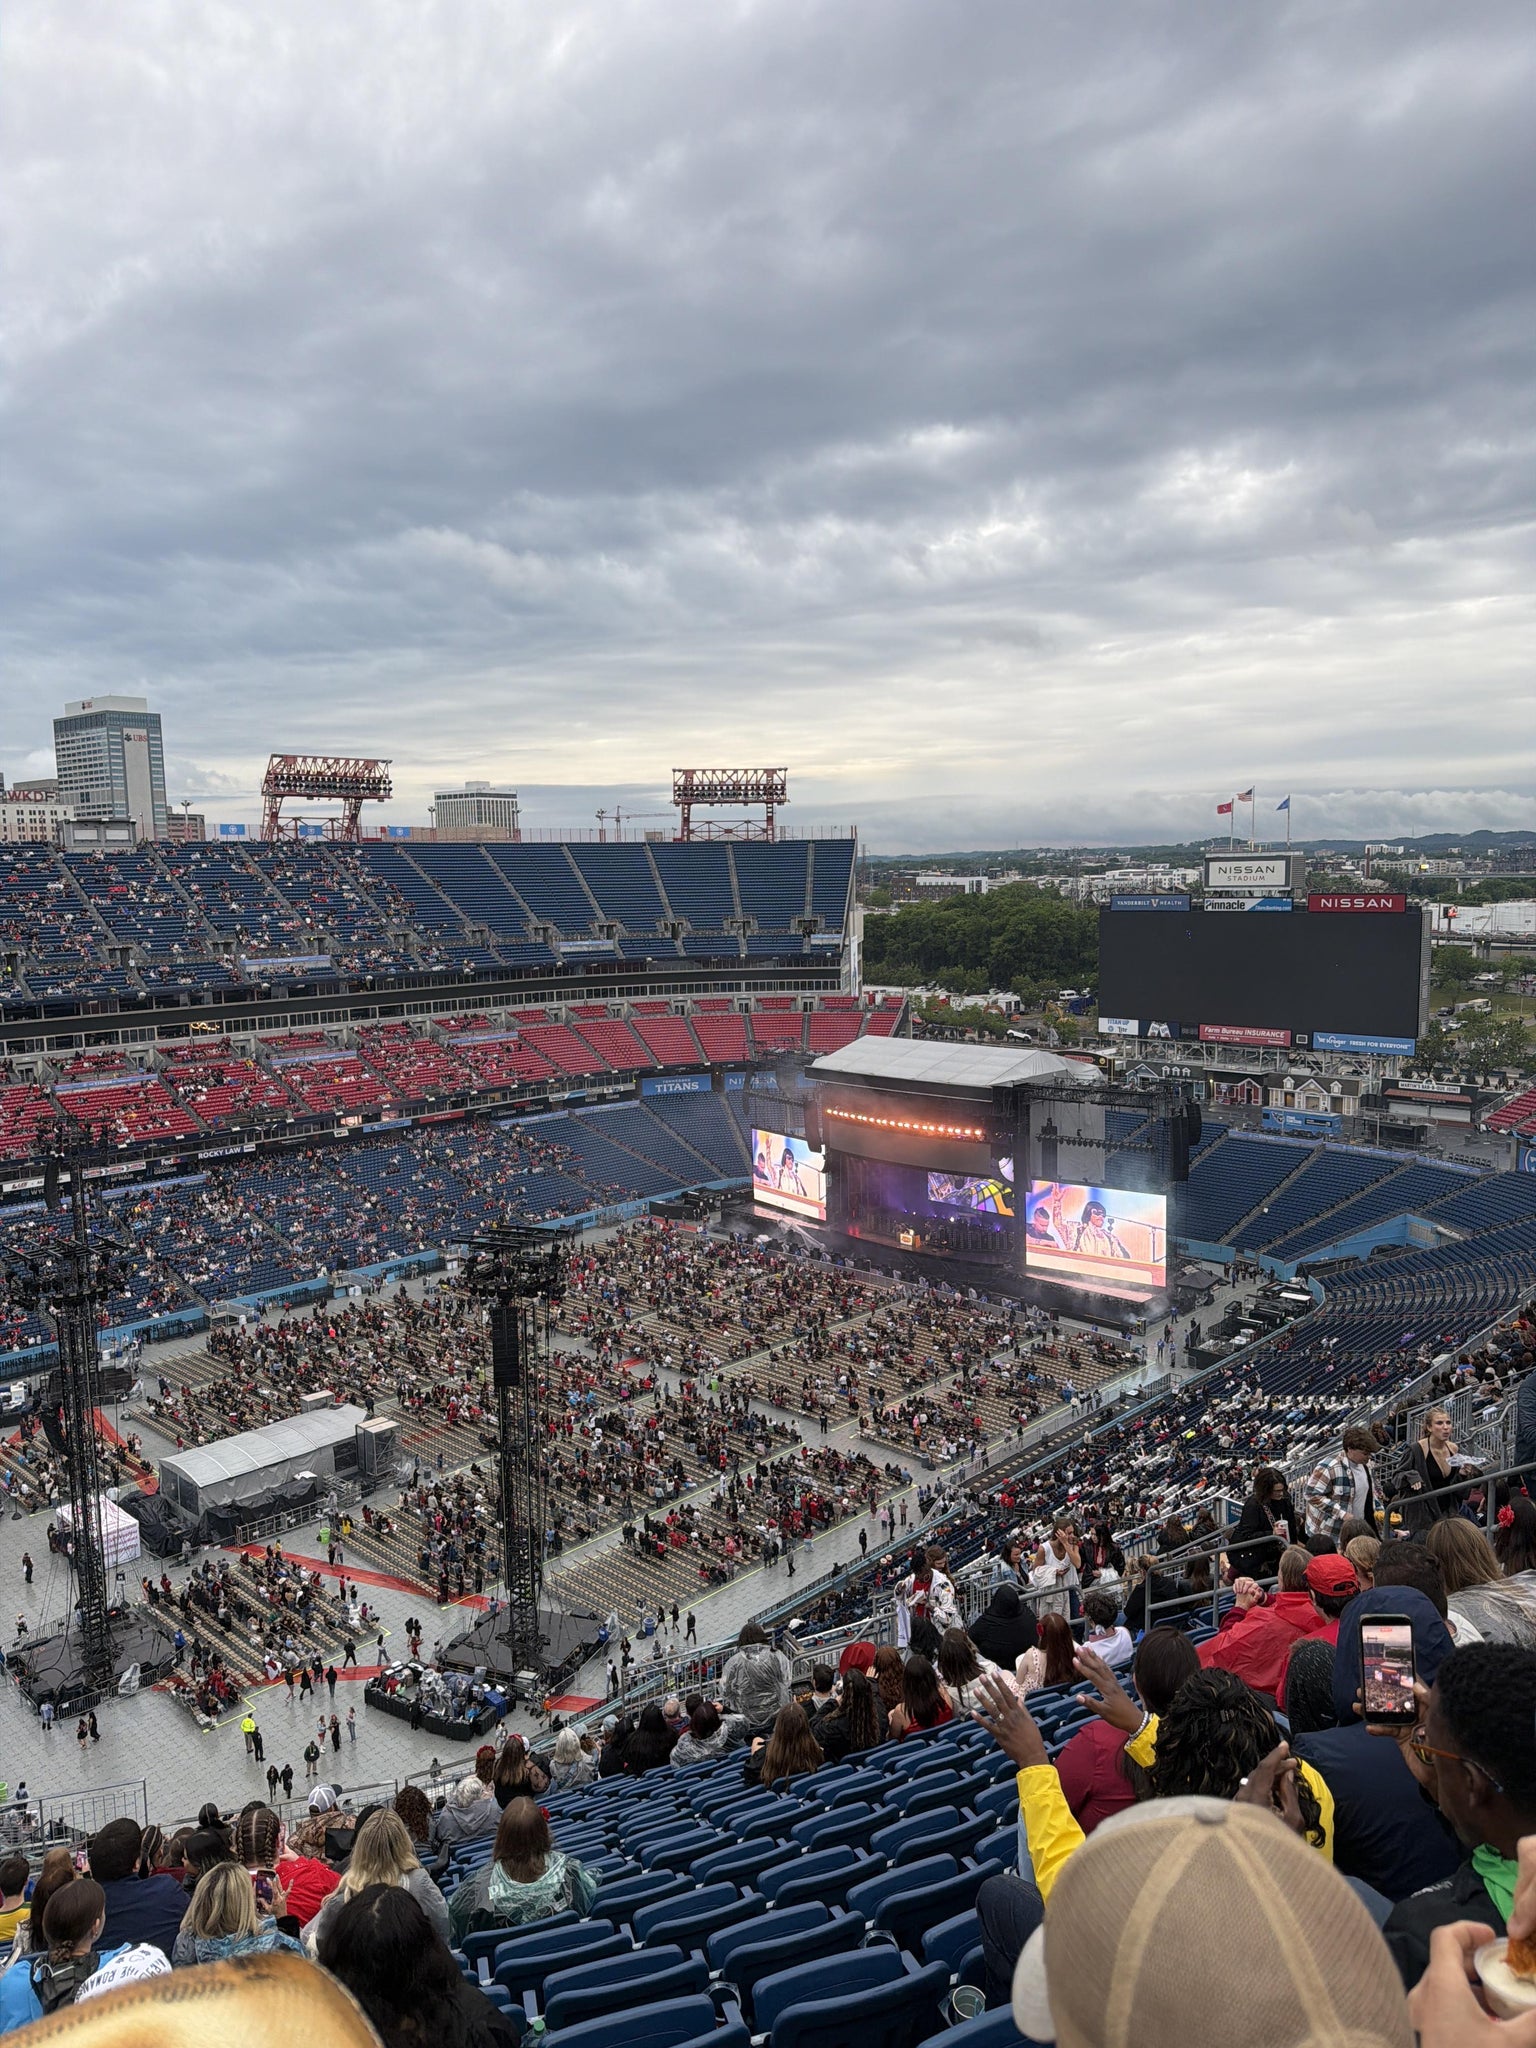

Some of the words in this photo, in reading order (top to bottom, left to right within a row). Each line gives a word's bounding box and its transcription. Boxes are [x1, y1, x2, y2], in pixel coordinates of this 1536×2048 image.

[133, 734, 148, 742] UBS
[7, 790, 56, 802] WKDF
[1218, 865, 1275, 874] NISSAN
[1205, 899, 1246, 910] Pinnacle
[1320, 898, 1393, 908] NISSAN
[1204, 1026, 1220, 1034] Farm
[1221, 1027, 1244, 1036] Bureau
[1244, 1029, 1285, 1039] INSURANCE
[1326, 1036, 1347, 1048] Kroger
[1379, 1042, 1408, 1050] EVERYONE
[655, 1081, 699, 1093] TITANS
[198, 1149, 223, 1160] ROCKY
[225, 1146, 241, 1156] LAW
[160, 1156, 182, 1166] FedEx
